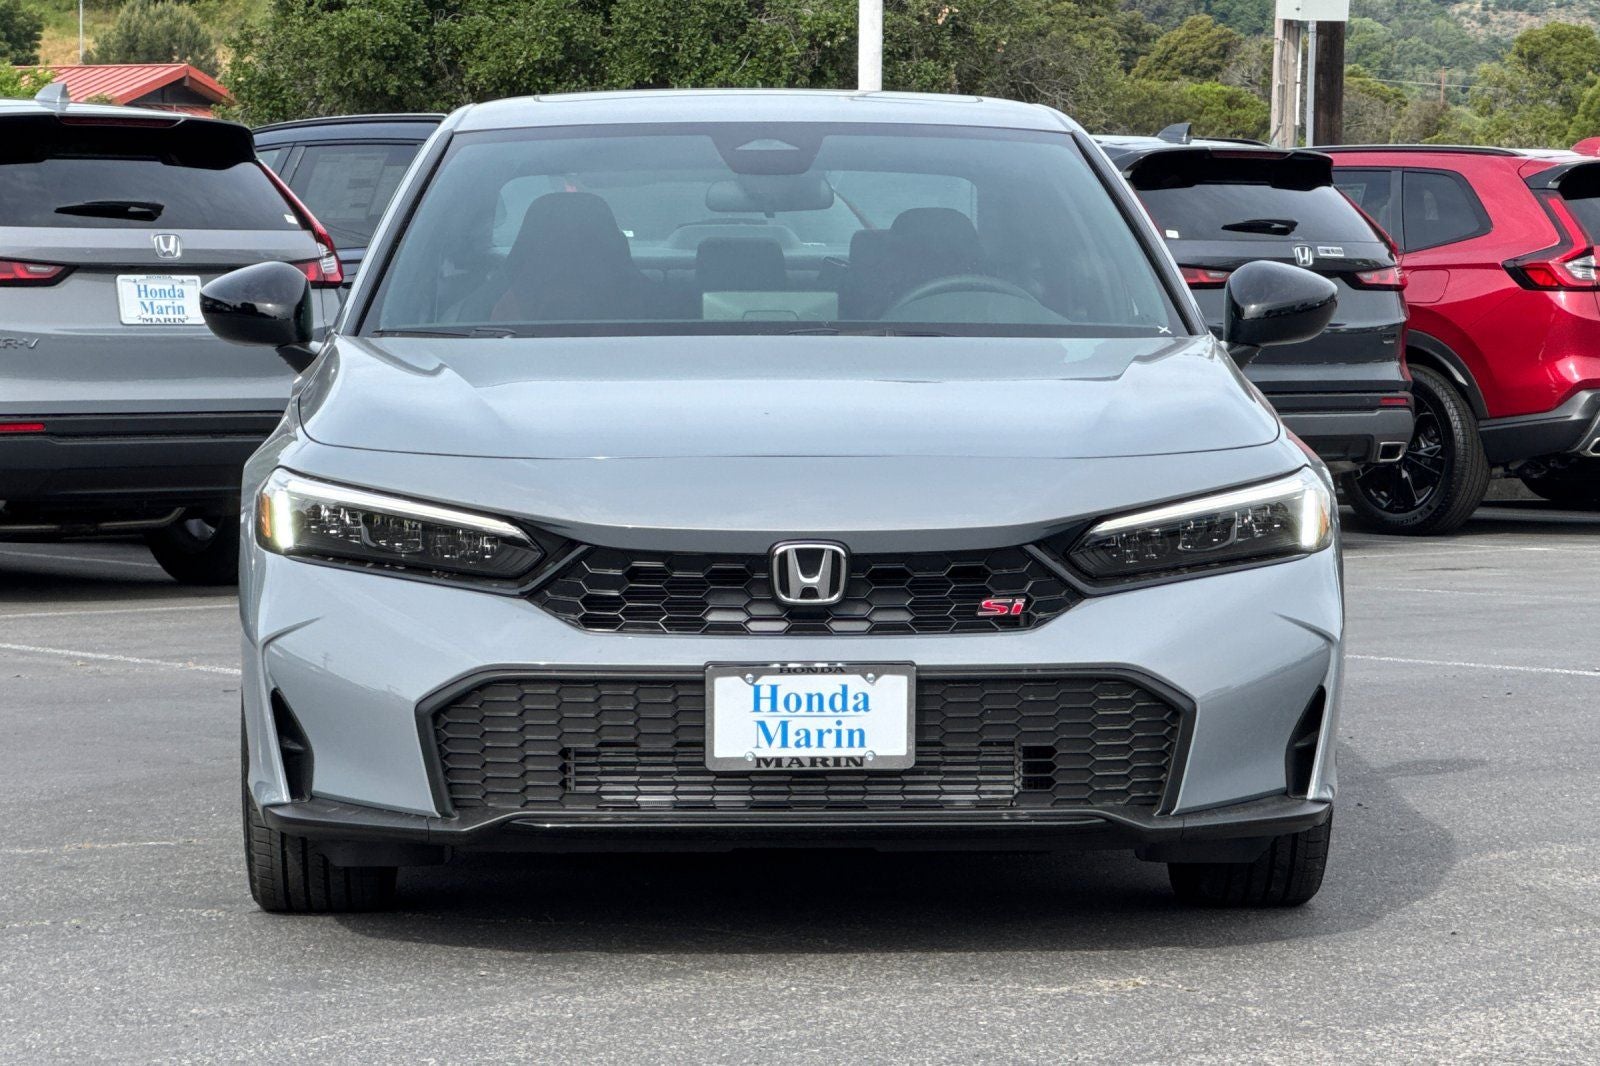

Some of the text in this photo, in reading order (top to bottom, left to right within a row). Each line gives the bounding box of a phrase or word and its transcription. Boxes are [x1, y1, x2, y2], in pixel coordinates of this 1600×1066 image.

[136, 284, 185, 298] Honda
[139, 301, 185, 315] Marin
[0, 337, 40, 350] R-V
[977, 598, 1026, 616] Si
[778, 666, 846, 674] HONDA
[750, 683, 872, 713] Honda
[752, 719, 868, 749] Marin
[754, 756, 866, 769] MARIN
